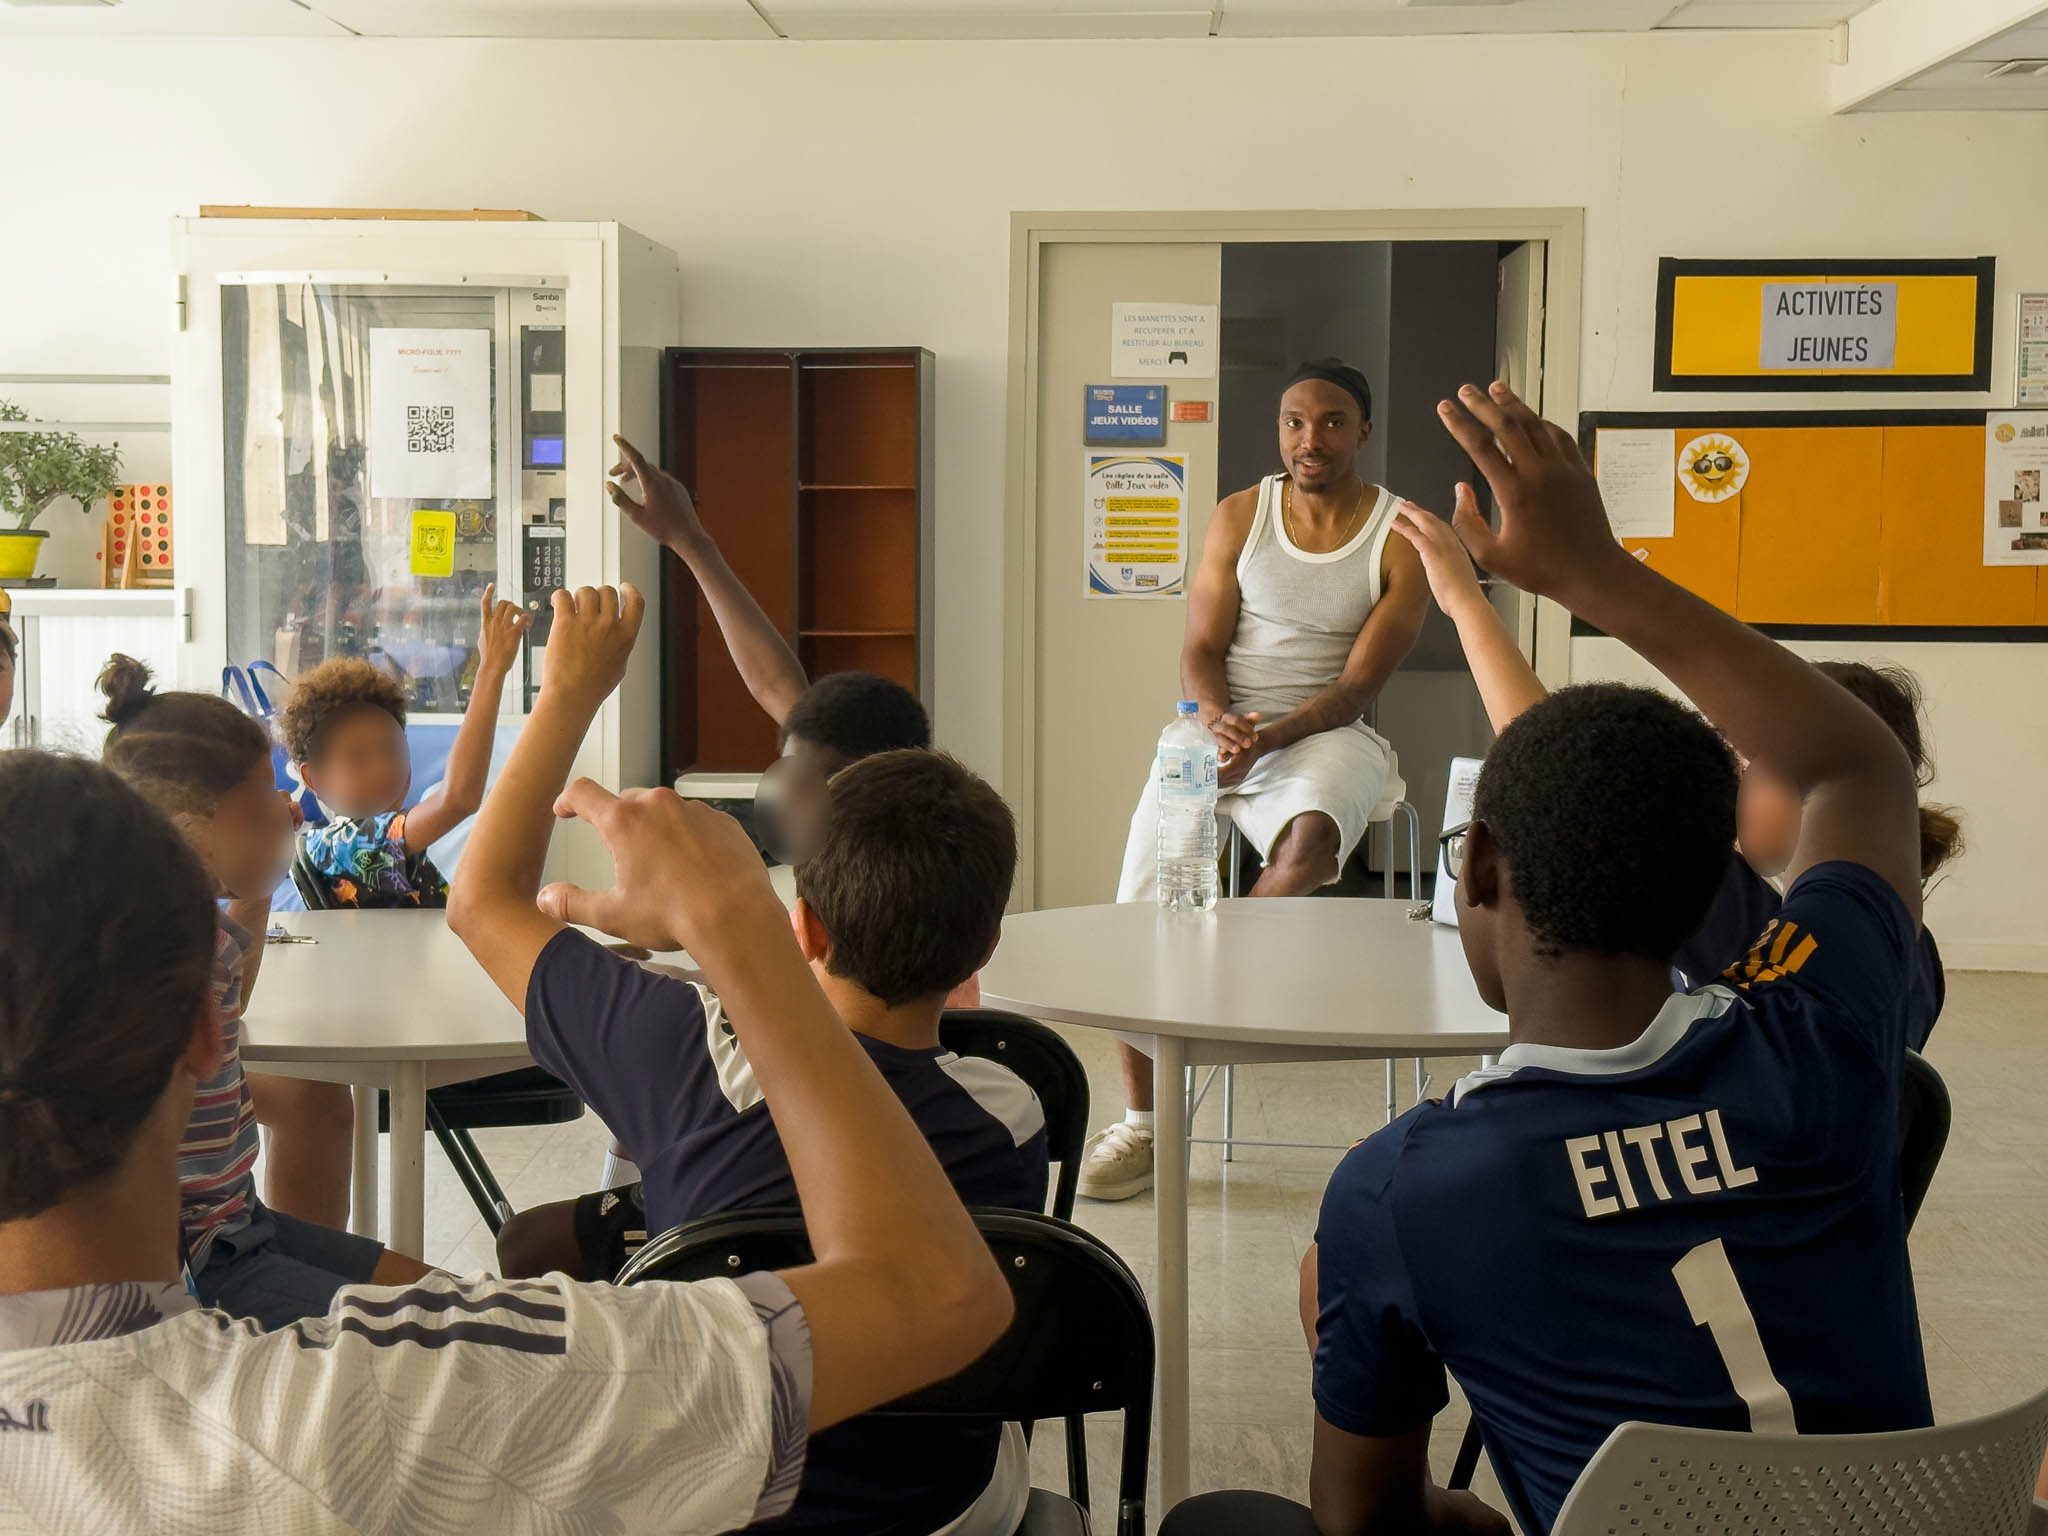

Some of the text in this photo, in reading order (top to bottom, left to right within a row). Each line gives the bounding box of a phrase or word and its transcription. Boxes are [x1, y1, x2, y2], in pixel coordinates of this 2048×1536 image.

[1776, 285, 1882, 316] ACTIVITÉS
[1787, 337, 1868, 362] JEUNES
[1091, 415, 1159, 425] JEUX VIDÉOS
[1108, 405, 1142, 414] SALLE
[1565, 1110, 1758, 1218] EITEL
[1671, 1237, 1798, 1435] 1
